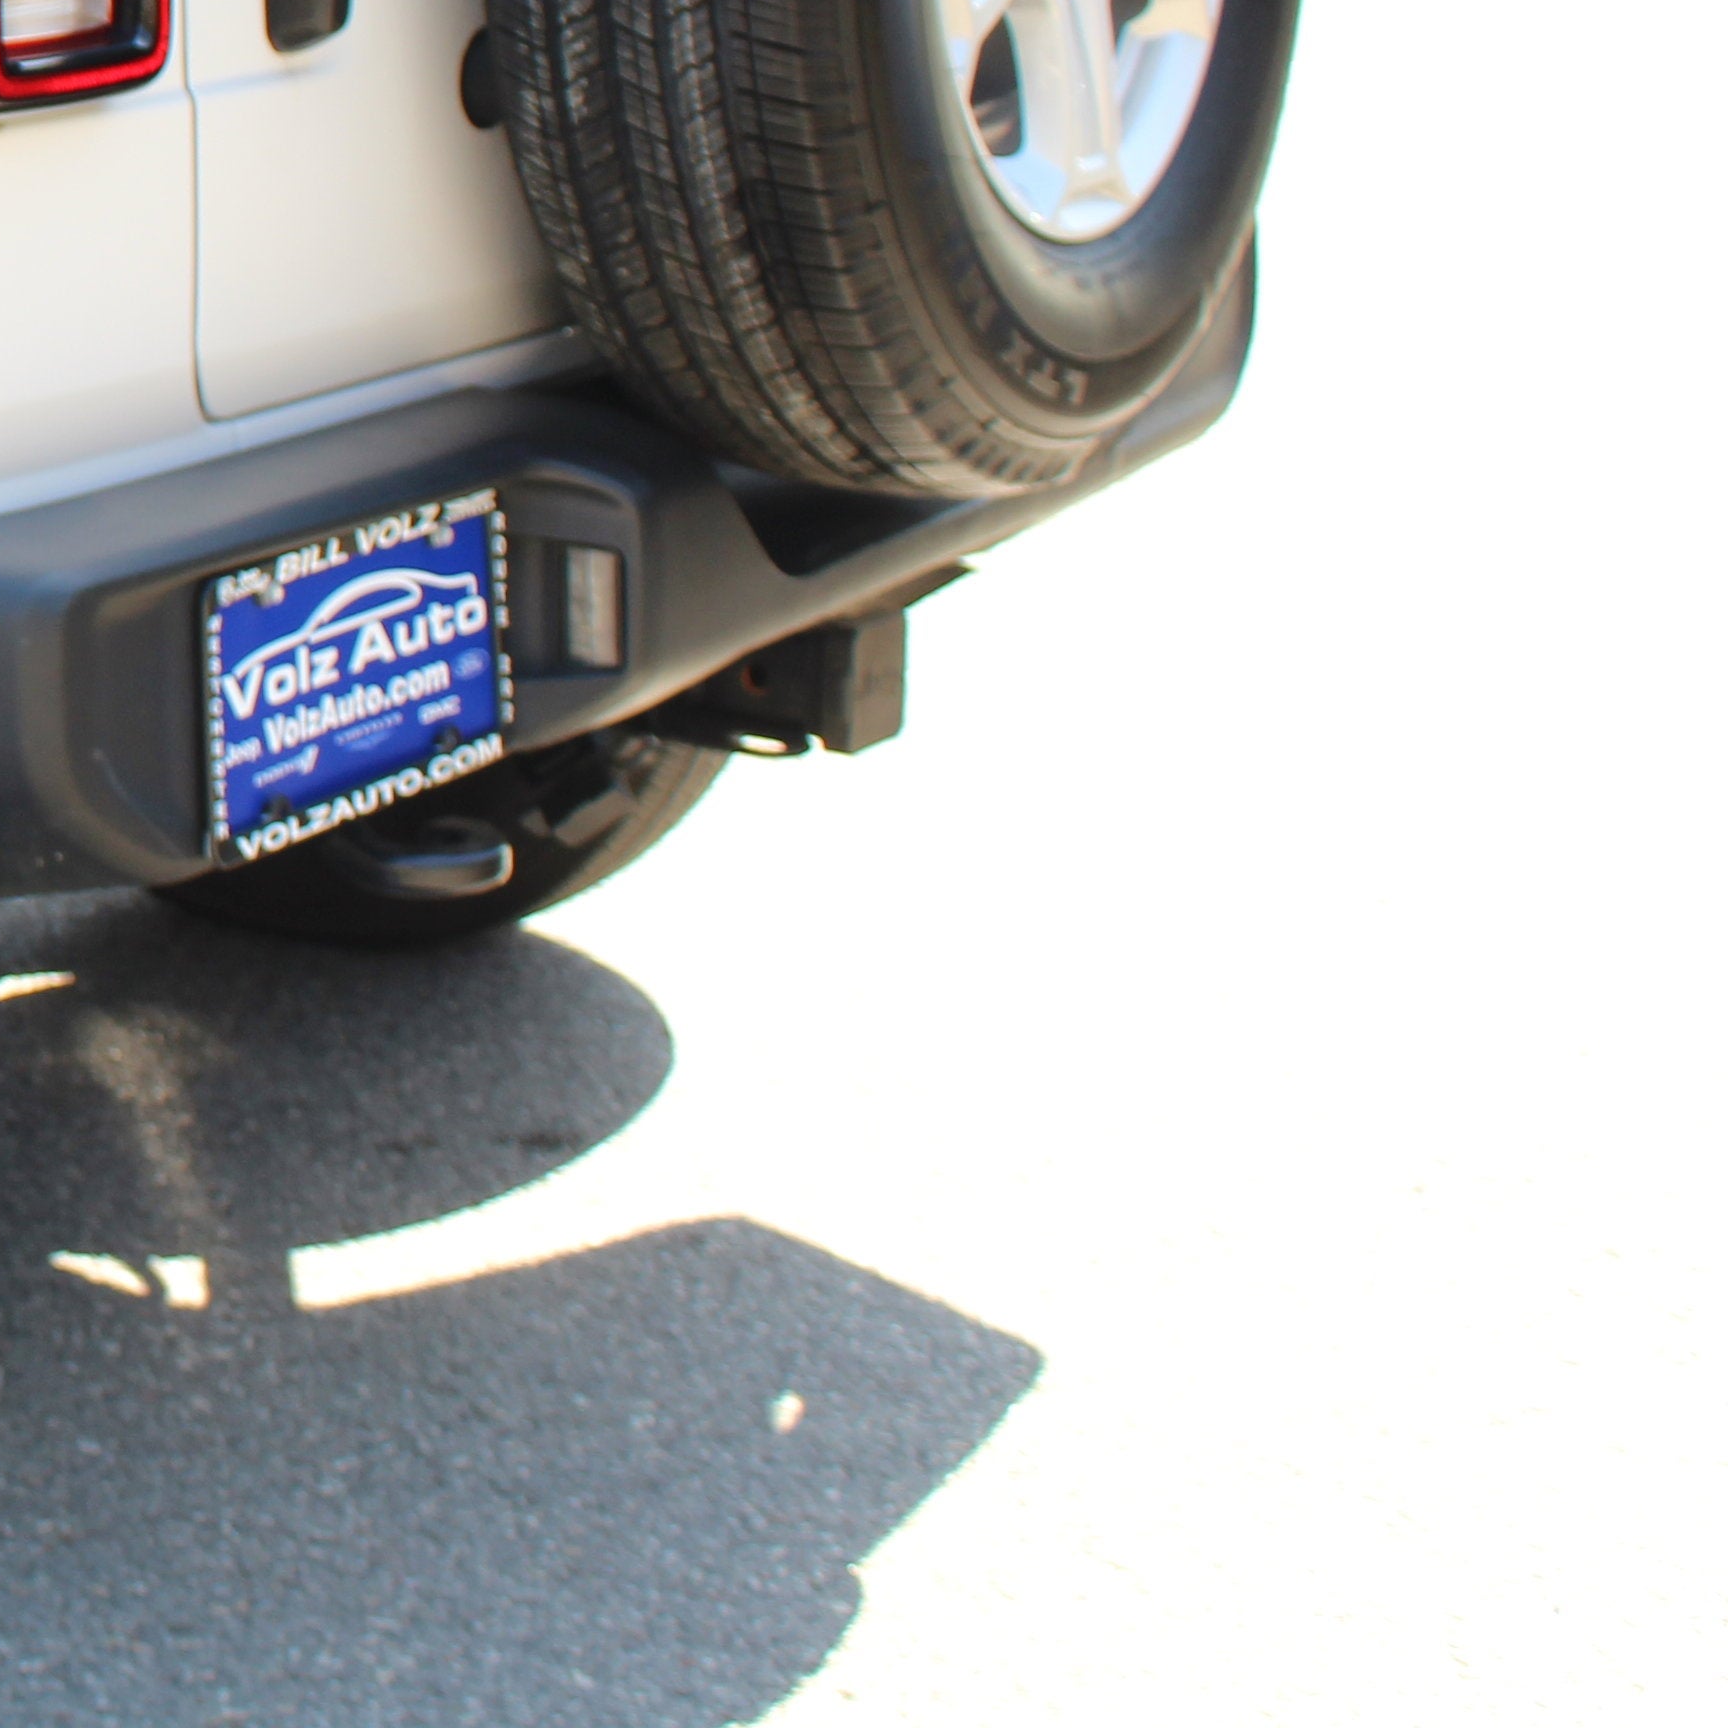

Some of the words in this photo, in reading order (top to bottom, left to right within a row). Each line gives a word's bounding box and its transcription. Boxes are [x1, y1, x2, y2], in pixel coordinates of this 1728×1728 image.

[275, 537, 349, 585] BILL
[355, 503, 441, 556] VOLZ
[223, 645, 340, 720] Volz
[348, 594, 488, 674] Auto
[262, 660, 450, 754] VolzAuto.com
[236, 732, 504, 861] VOLZAUTO.COM
